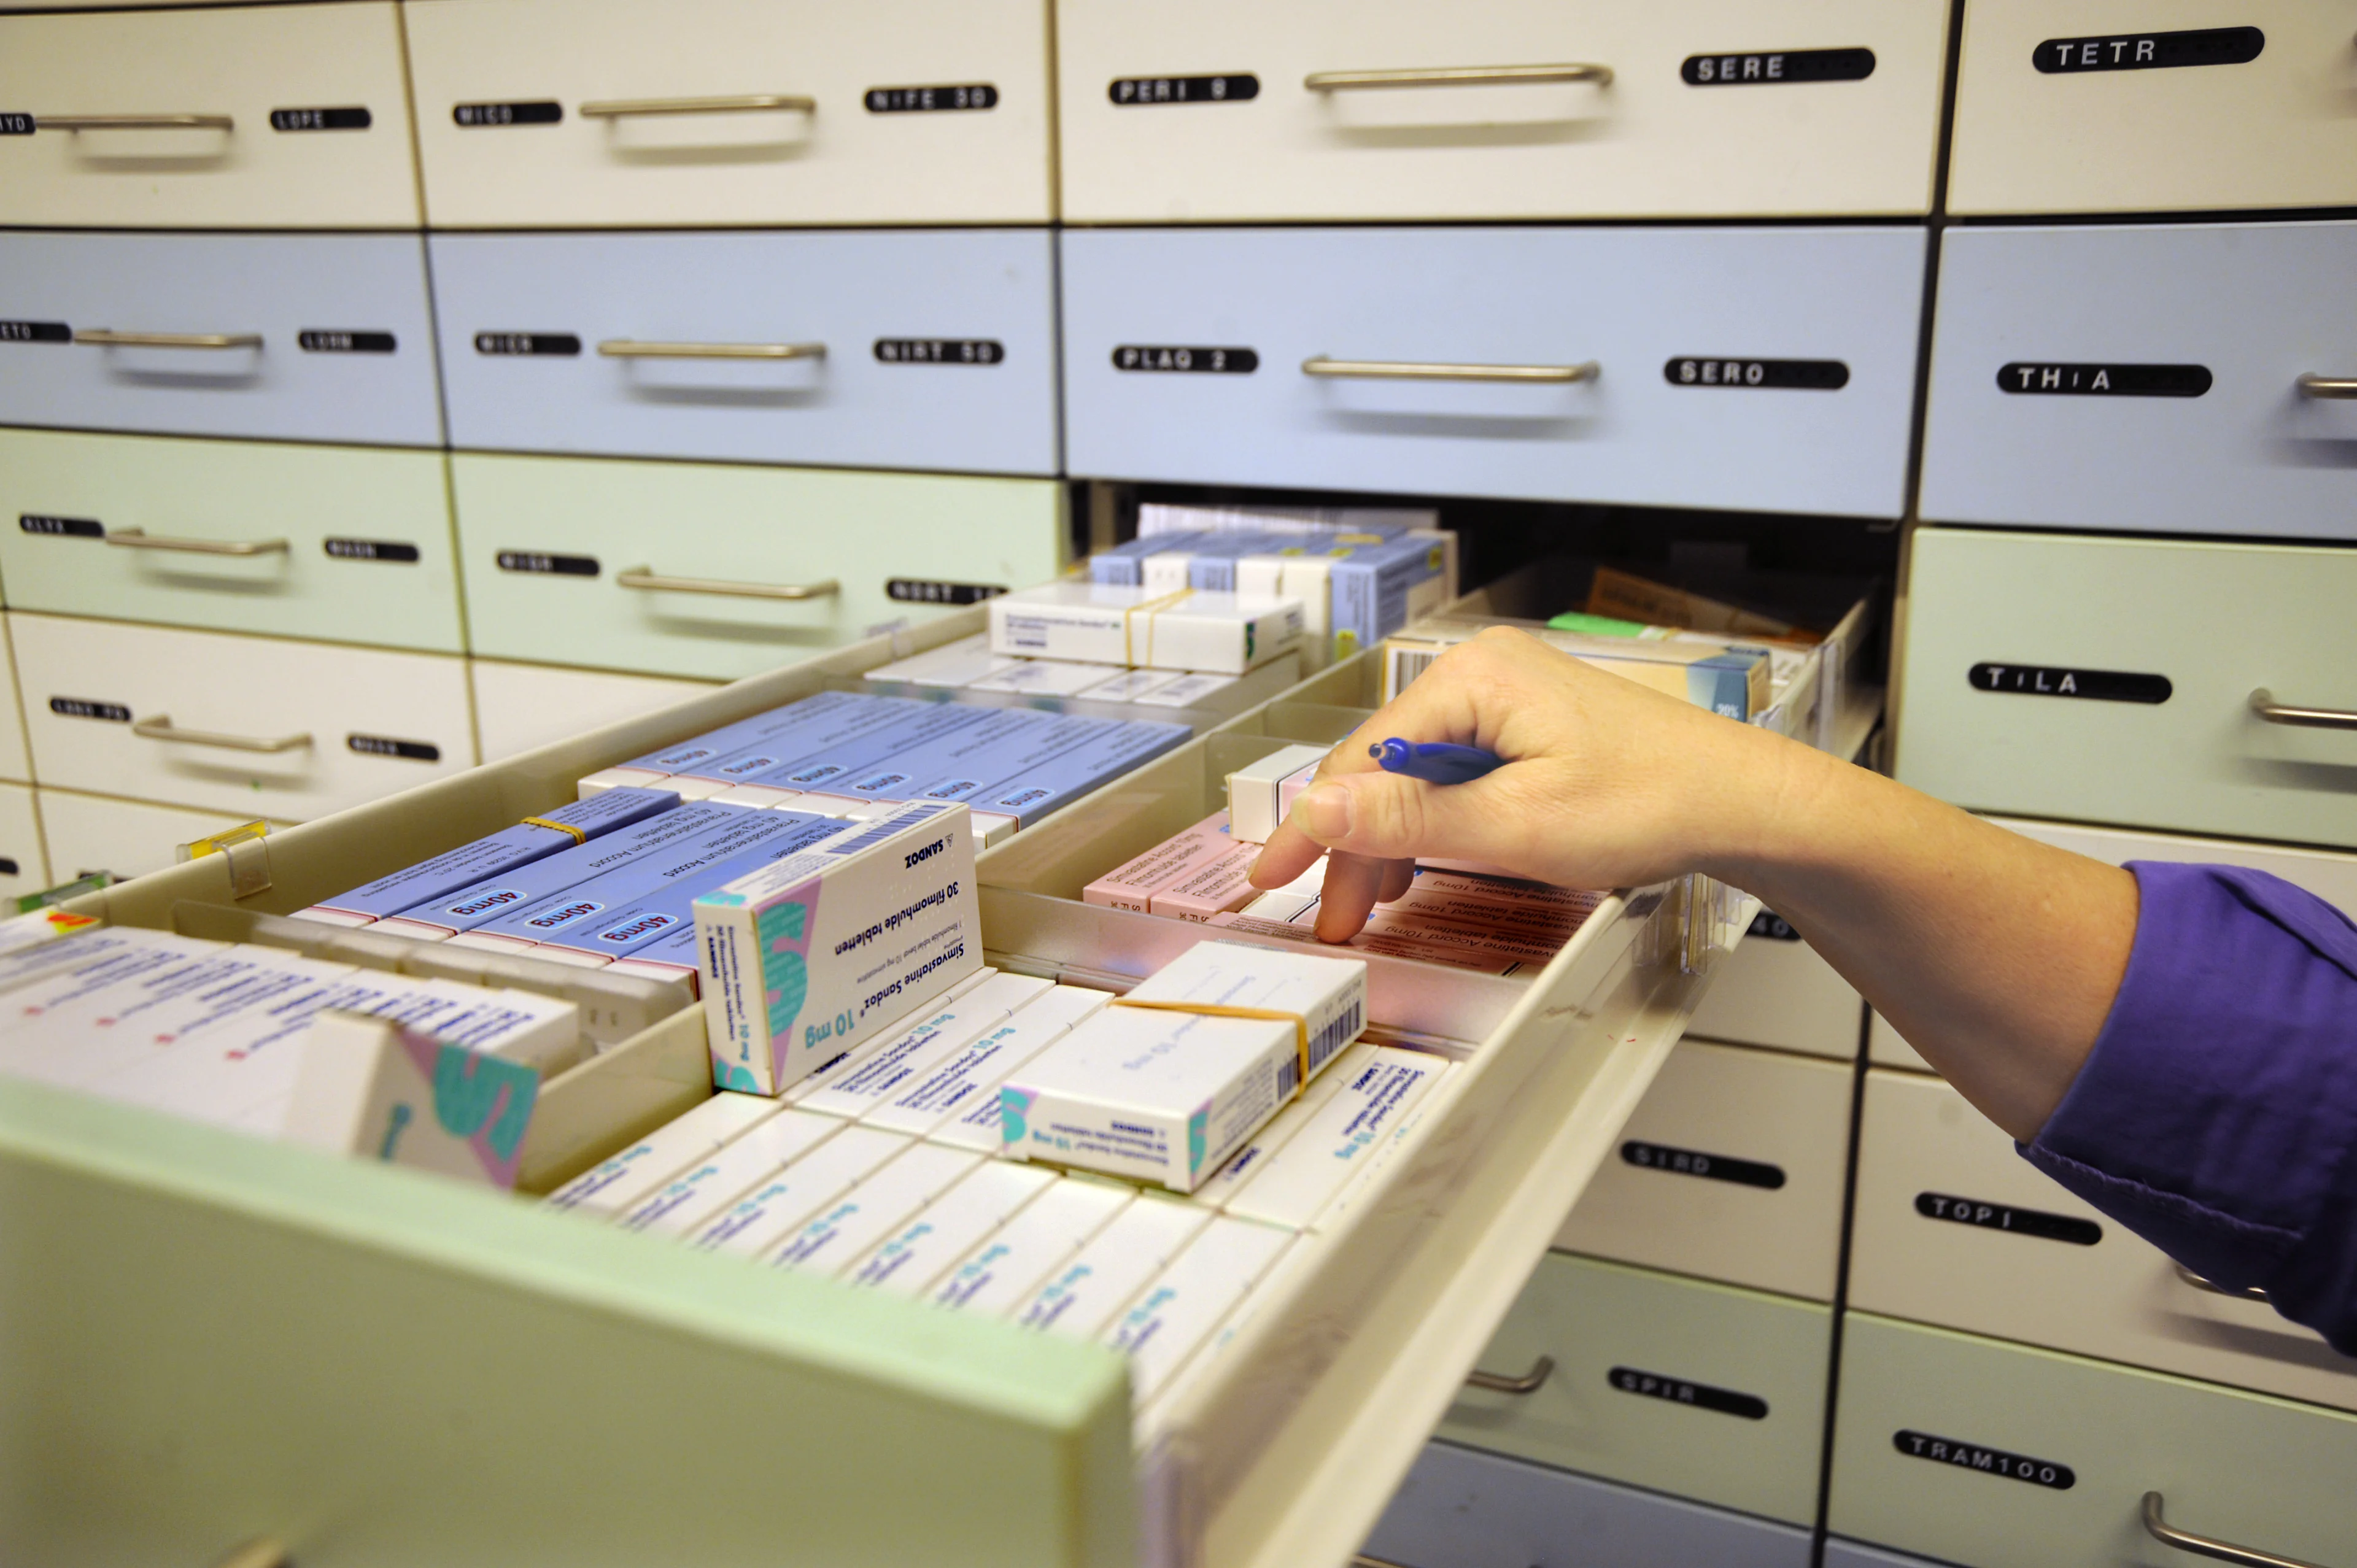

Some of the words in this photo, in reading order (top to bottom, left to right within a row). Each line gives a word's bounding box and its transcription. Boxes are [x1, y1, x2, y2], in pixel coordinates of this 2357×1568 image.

[2056, 39, 2154, 64] TETR
[1698, 56, 1783, 80] SERE
[1120, 79, 1186, 101] PERI
[1679, 361, 1763, 385] SERO
[1987, 667, 2077, 692] TILA
[905, 839, 944, 869] SANDOZ
[946, 881, 960, 898] 30
[1433, 879, 1471, 892] 10mg
[1474, 884, 1524, 900] Accord
[452, 891, 518, 916] 40mg
[530, 903, 596, 928] 40mg
[884, 889, 946, 931] filmomhulde
[1409, 900, 1448, 914] 10mg
[1447, 900, 1508, 916] tabletten
[1450, 908, 1505, 923] Accord
[605, 915, 670, 941] 40mg
[835, 923, 883, 956] tabletten
[1384, 925, 1425, 940] 10mg
[1425, 924, 1488, 940] tabletten
[1426, 933, 1481, 948] Accord
[905, 943, 964, 986] Simvastatine
[805, 1021, 832, 1049] mg
[835, 1009, 855, 1037] 10
[1933, 1198, 2011, 1227] TOPI
[1622, 1372, 1695, 1402] SPIR
[1911, 1437, 2055, 1484] TRAM100
